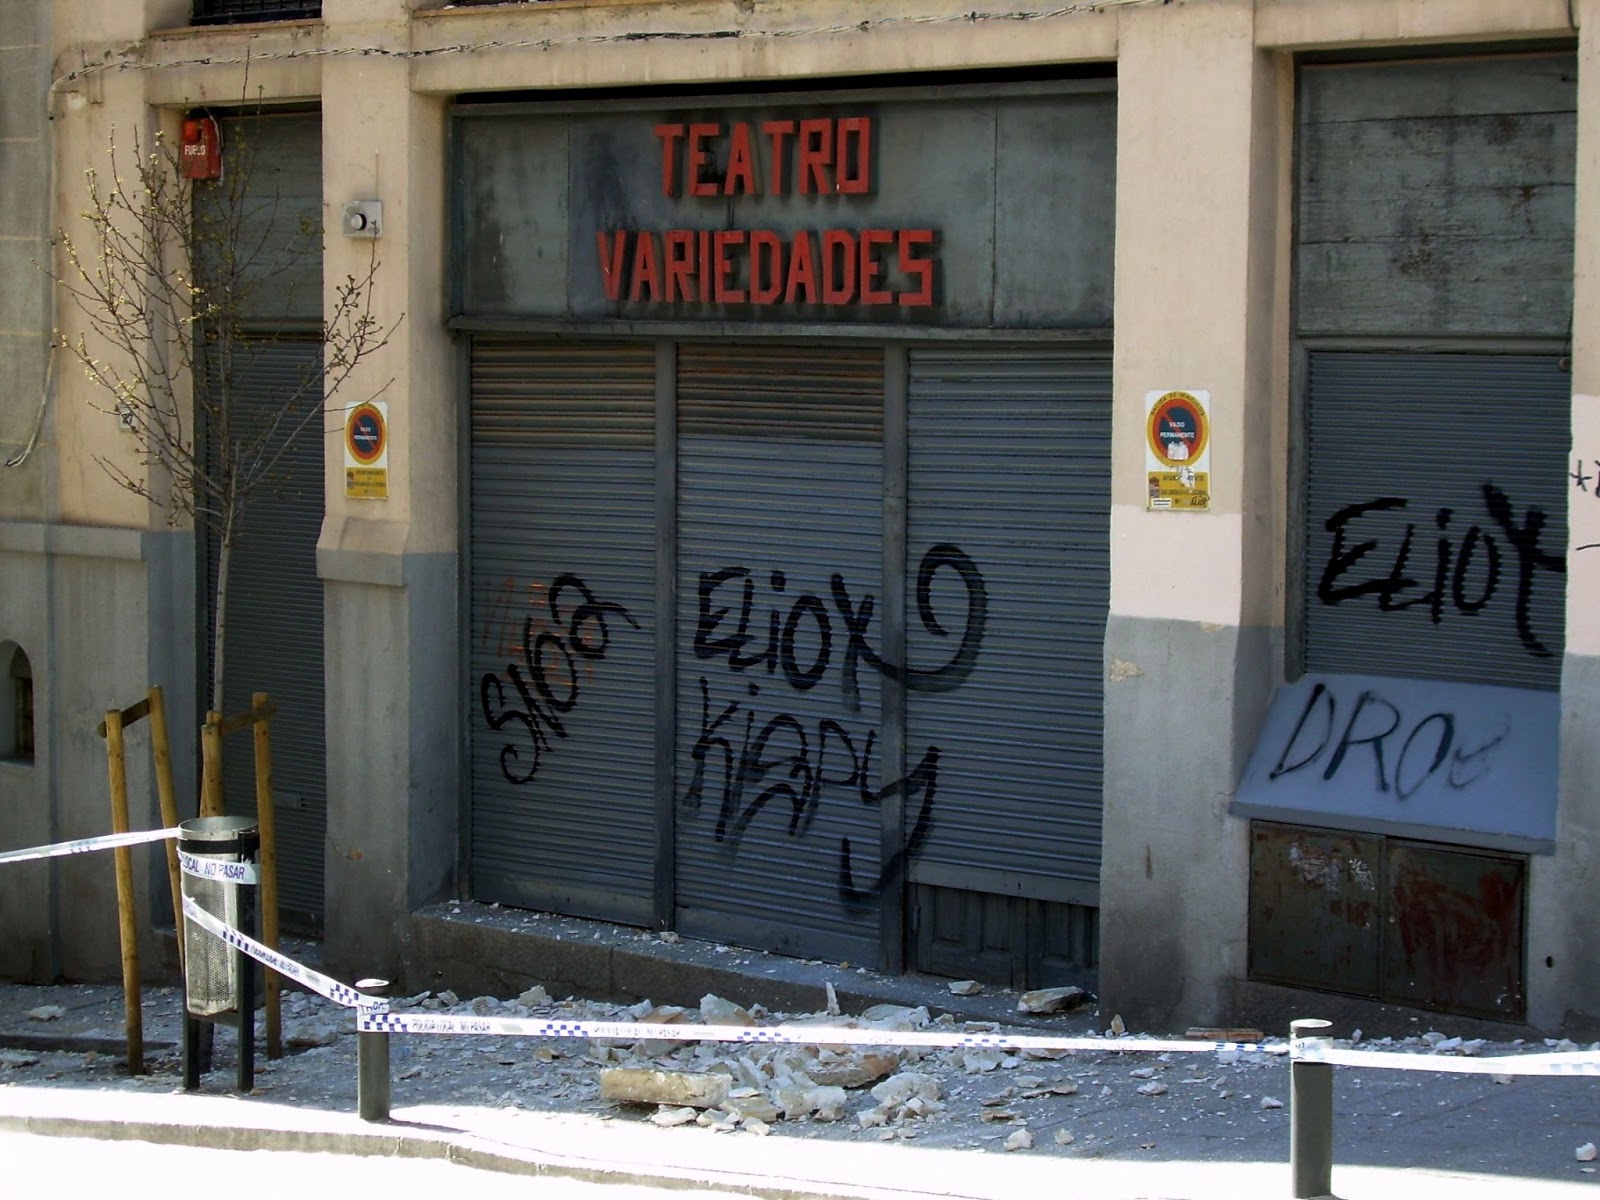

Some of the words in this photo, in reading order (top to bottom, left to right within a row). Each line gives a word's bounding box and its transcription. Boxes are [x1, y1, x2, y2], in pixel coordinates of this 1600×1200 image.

[655, 117, 871, 197] TEATRO
[596, 229, 934, 306] VARIEDADES
[204, 861, 217, 876] NO
[219, 863, 245, 880] PASAR
